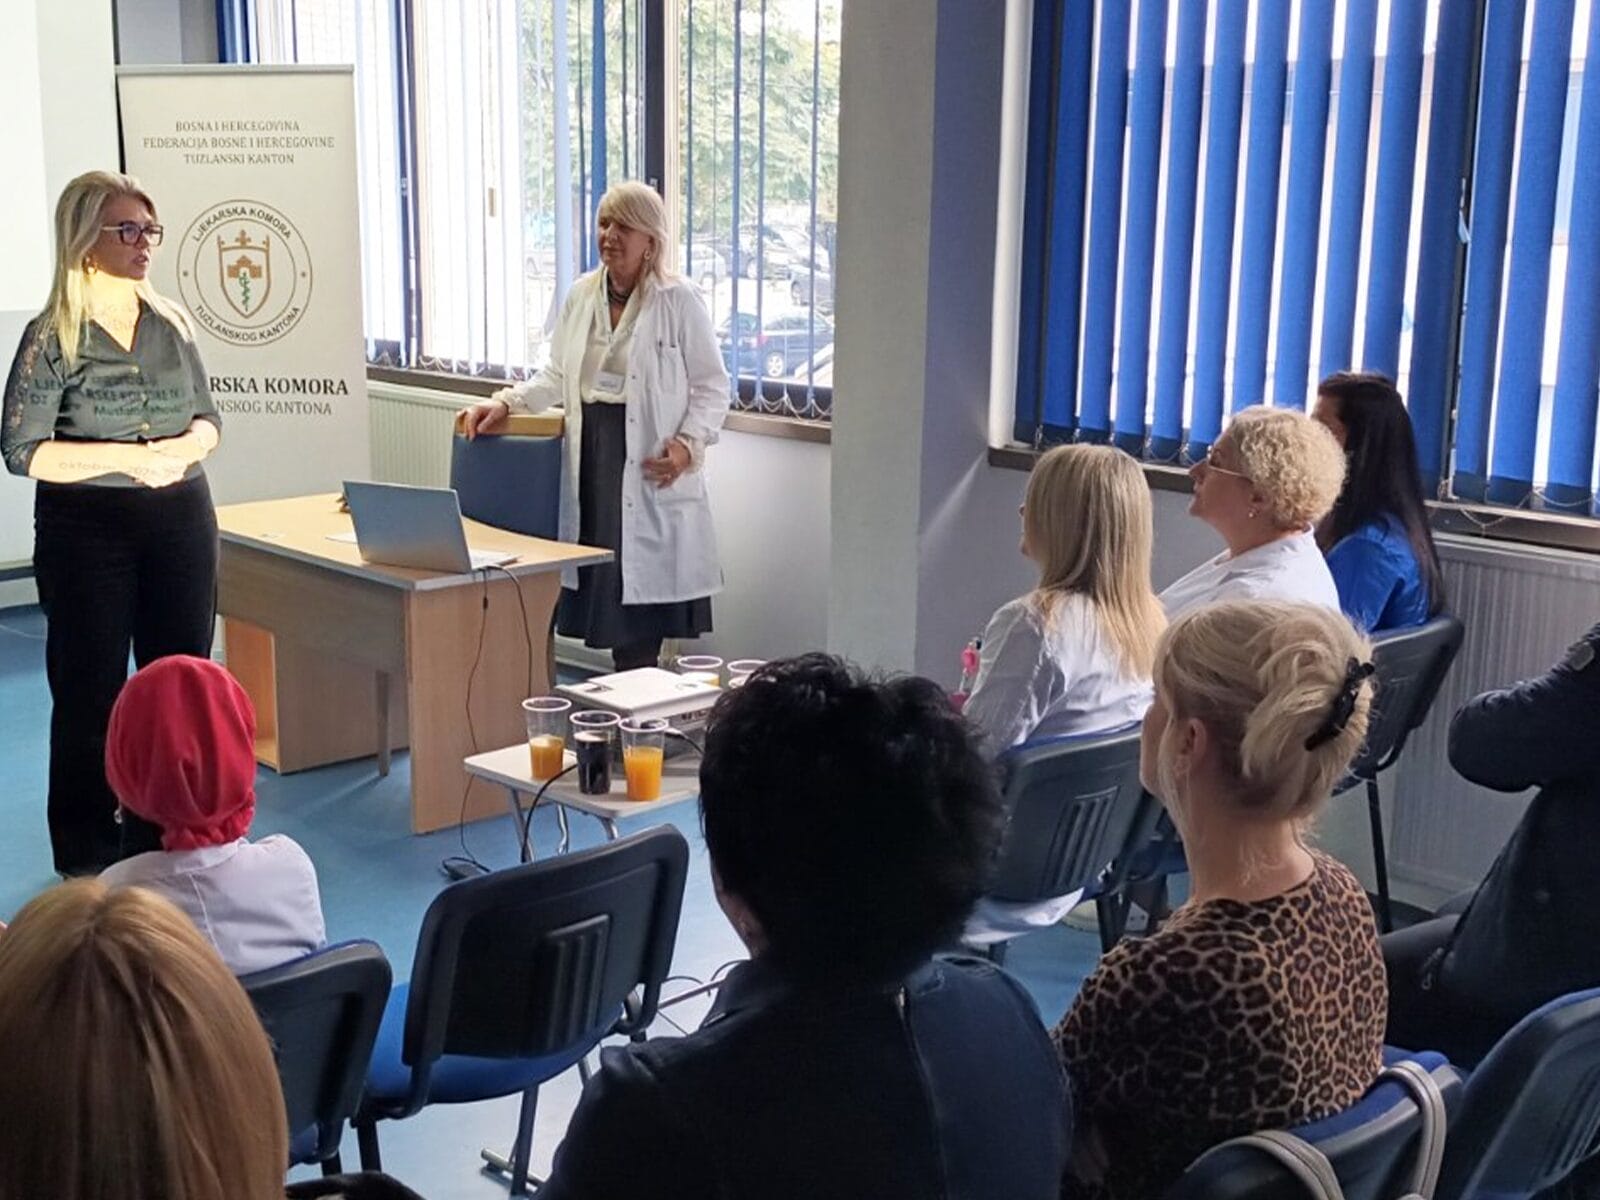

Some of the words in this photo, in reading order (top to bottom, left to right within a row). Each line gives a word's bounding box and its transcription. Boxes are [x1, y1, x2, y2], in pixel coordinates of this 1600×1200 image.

[175, 121, 213, 132] BOSNA
[222, 121, 300, 132] HERCEGOVINA
[143, 136, 208, 149] FEDERACIJA
[211, 136, 247, 149] BOSNE
[256, 136, 335, 149] HERCEGOVINE
[183, 153, 245, 165] TUZLANSKI
[249, 153, 295, 165] KANTON
[192, 206, 247, 243] LJEKARSKA
[249, 207, 292, 240] KOMORA
[195, 305, 258, 342] TUZLANSKOG
[259, 306, 301, 340] KANTONA
[264, 377, 349, 396] KOMORA
[215, 399, 262, 414] NSKOG
[265, 400, 332, 415] KANTONA
